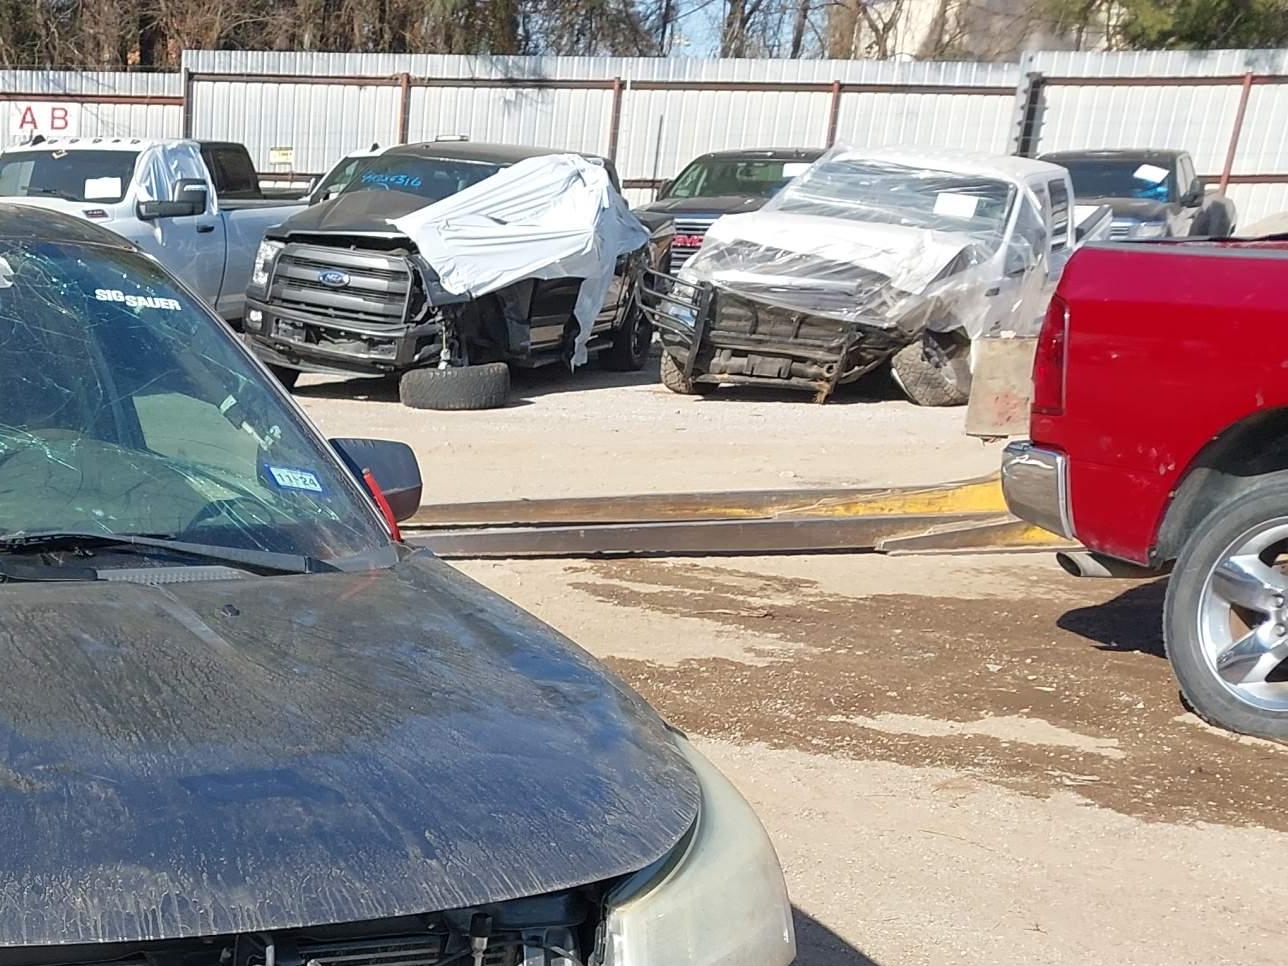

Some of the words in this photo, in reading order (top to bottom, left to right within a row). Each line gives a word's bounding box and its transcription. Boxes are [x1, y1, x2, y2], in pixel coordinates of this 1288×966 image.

[19, 106, 38, 130] A
[50, 107, 69, 130] B
[94, 288, 126, 302] SIG
[124, 295, 182, 311] SAUER
